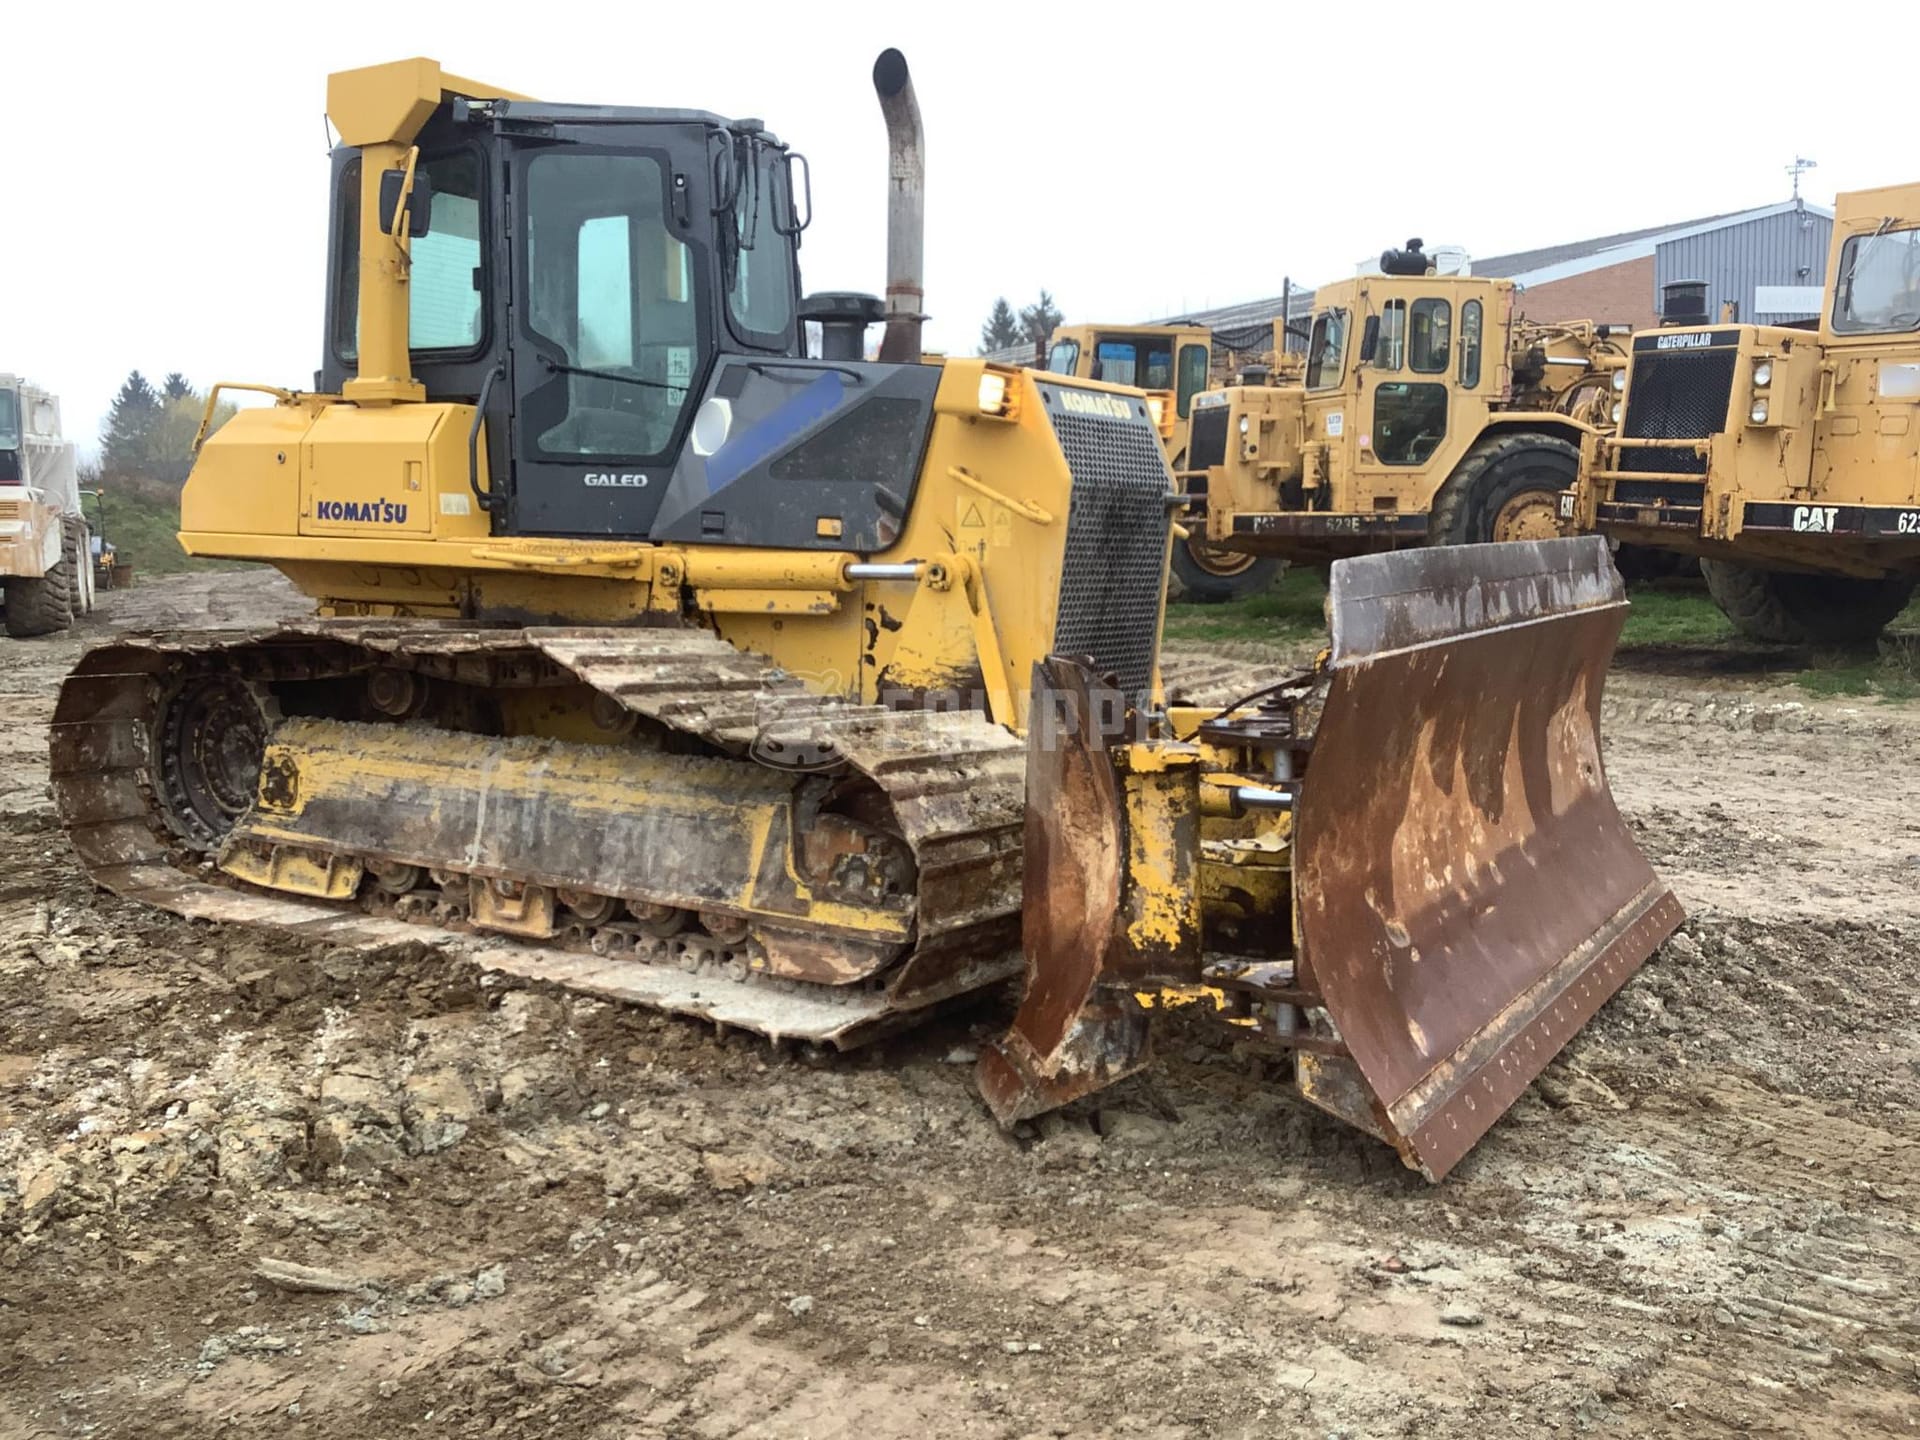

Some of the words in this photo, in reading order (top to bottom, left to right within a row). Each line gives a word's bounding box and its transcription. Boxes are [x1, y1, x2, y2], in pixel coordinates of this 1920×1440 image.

[1657, 332, 1712, 349] CATERPILLAR
[1059, 391, 1132, 419] KOMATSU
[584, 473, 648, 487] GALEO
[317, 497, 407, 524] KOMATSU
[1793, 506, 1839, 533] CAT
